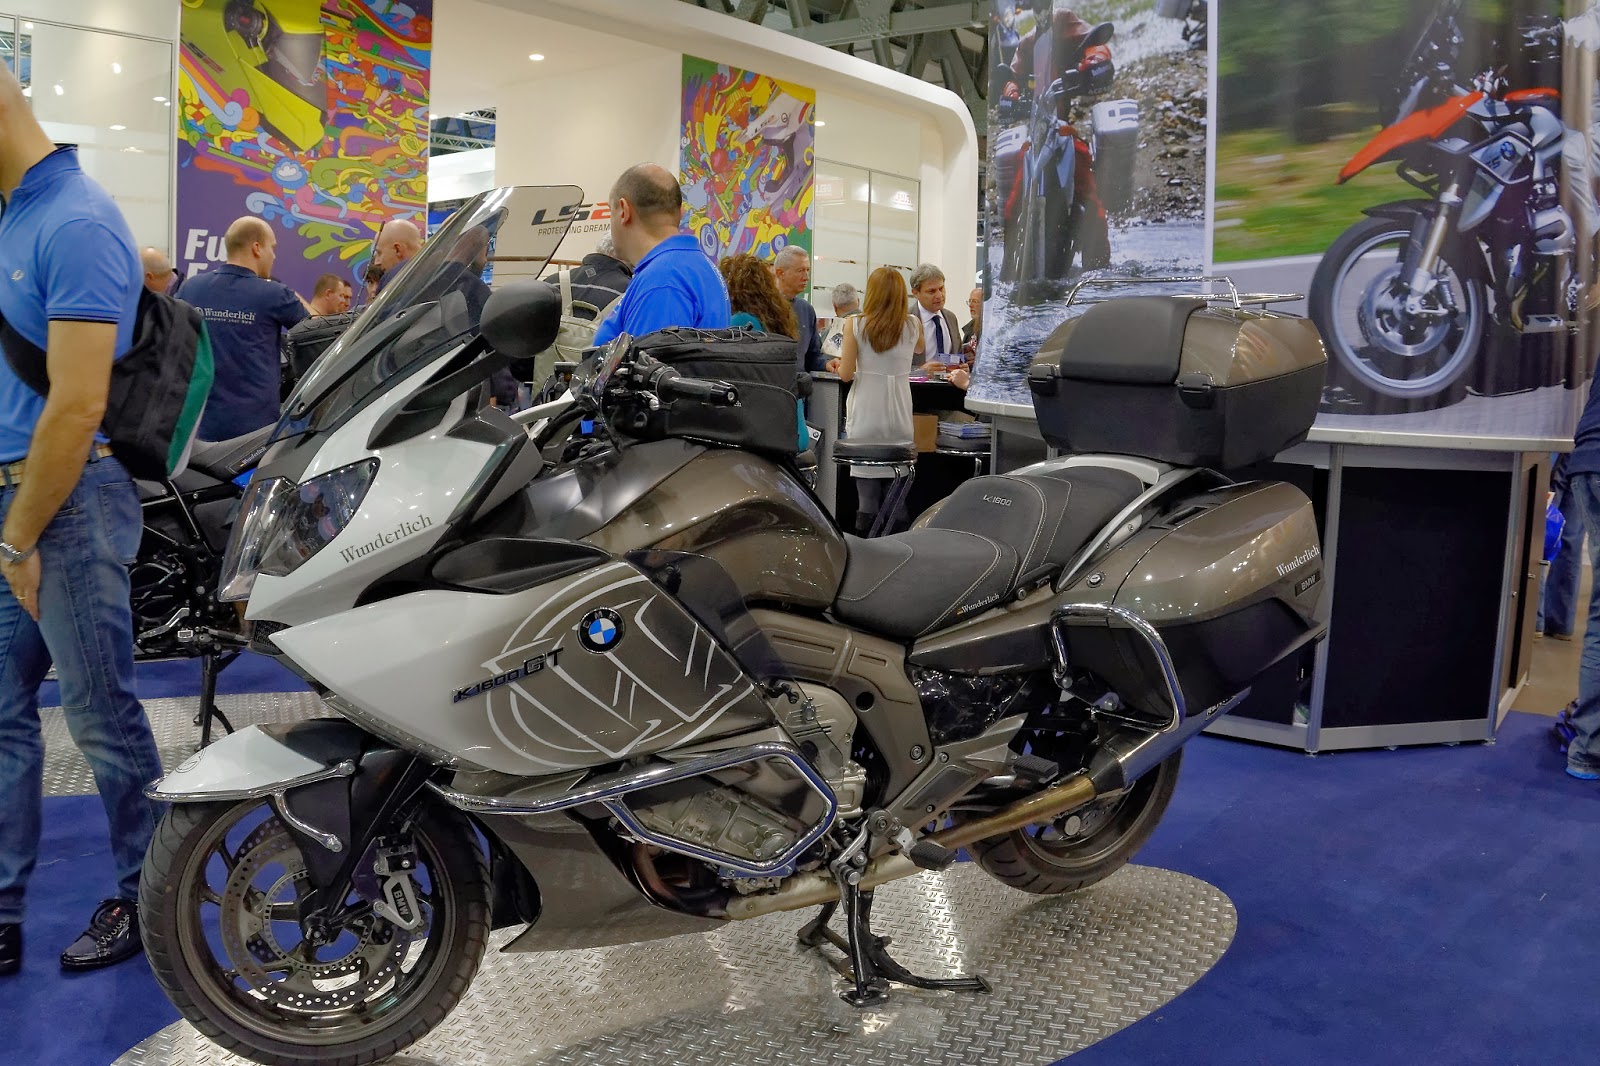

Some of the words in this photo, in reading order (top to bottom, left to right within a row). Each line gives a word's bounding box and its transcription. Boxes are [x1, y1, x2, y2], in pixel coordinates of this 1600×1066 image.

[531, 202, 611, 225] LS2
[204, 307, 256, 321] Wunderlich
[339, 514, 434, 563] Wunderlich
[1276, 544, 1320, 577] Wunderlich
[1301, 575, 1316, 591] BMW
[962, 593, 1000, 613] Wunderlich
[455, 669, 520, 702] K1600
[523, 647, 564, 676] GT
[393, 890, 409, 915] BMW
